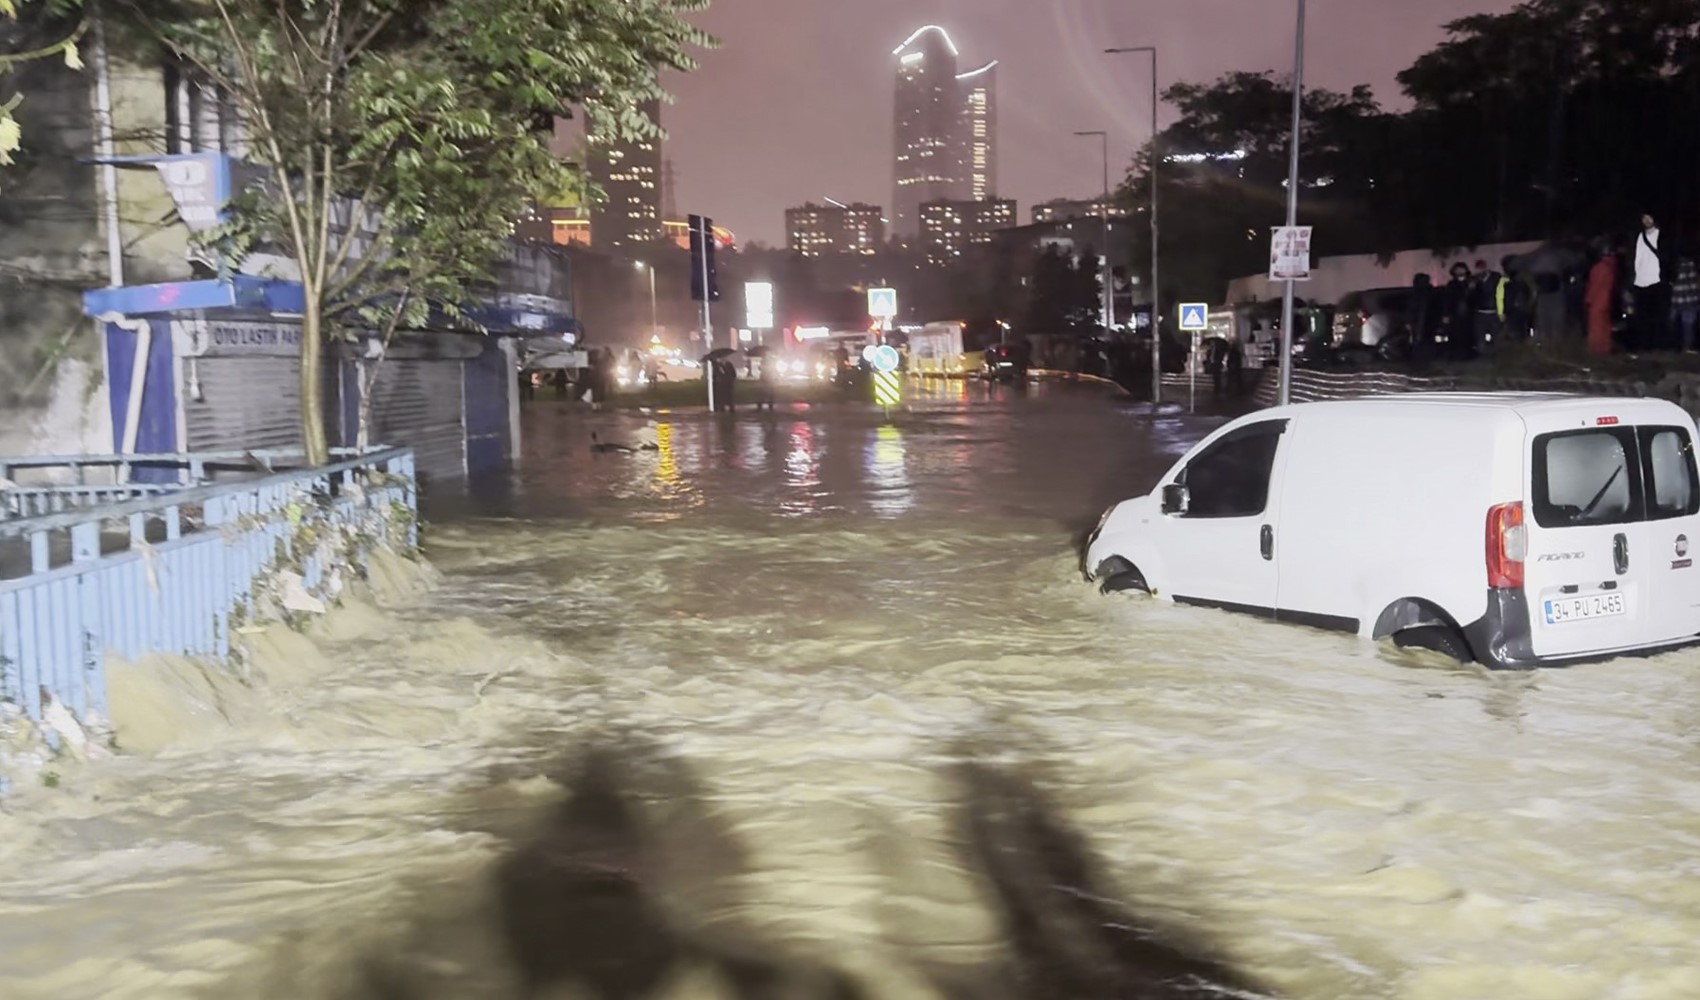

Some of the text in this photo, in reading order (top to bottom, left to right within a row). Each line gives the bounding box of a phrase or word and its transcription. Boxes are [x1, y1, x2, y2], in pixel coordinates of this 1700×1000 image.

[215, 327, 238, 345] OTO
[1554, 595, 1622, 620] 34 PU 2465
